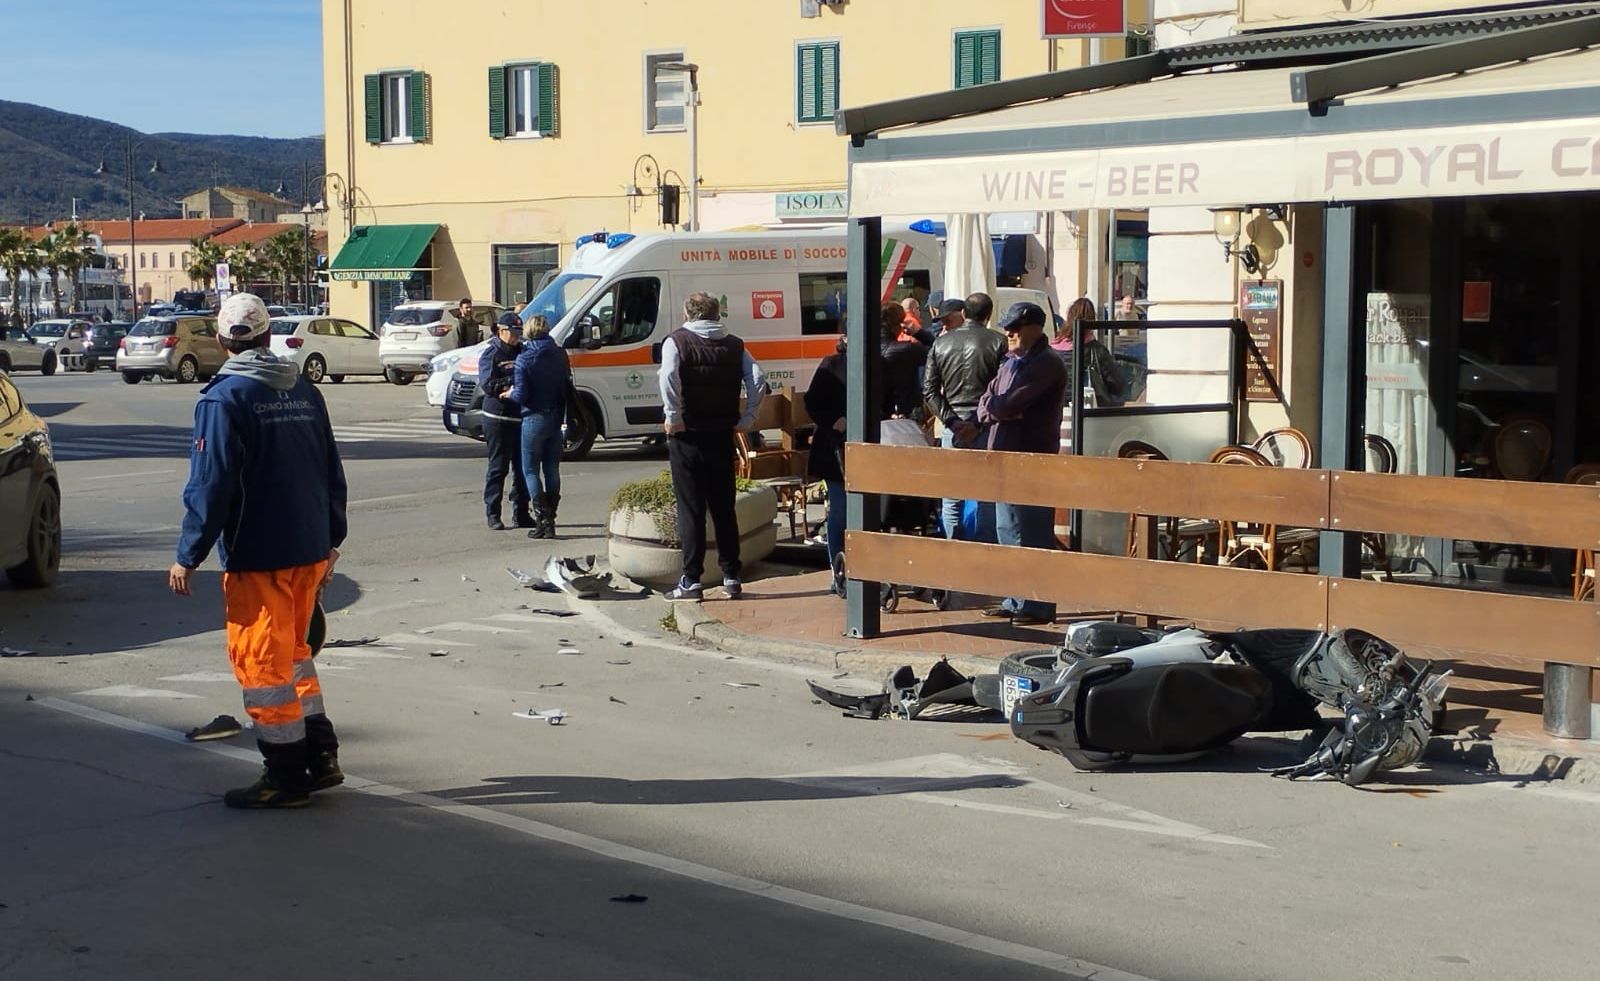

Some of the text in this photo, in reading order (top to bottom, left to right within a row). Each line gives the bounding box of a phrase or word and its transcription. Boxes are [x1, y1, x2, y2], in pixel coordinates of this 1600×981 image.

[1324, 137, 1600, 192] ROYAL C
[982, 170, 1067, 202] WINE
[1107, 163, 1200, 196] BEER
[786, 194, 844, 209] ISOLA
[681, 247, 847, 262] UNITÀ MOBILE DI SOCCO
